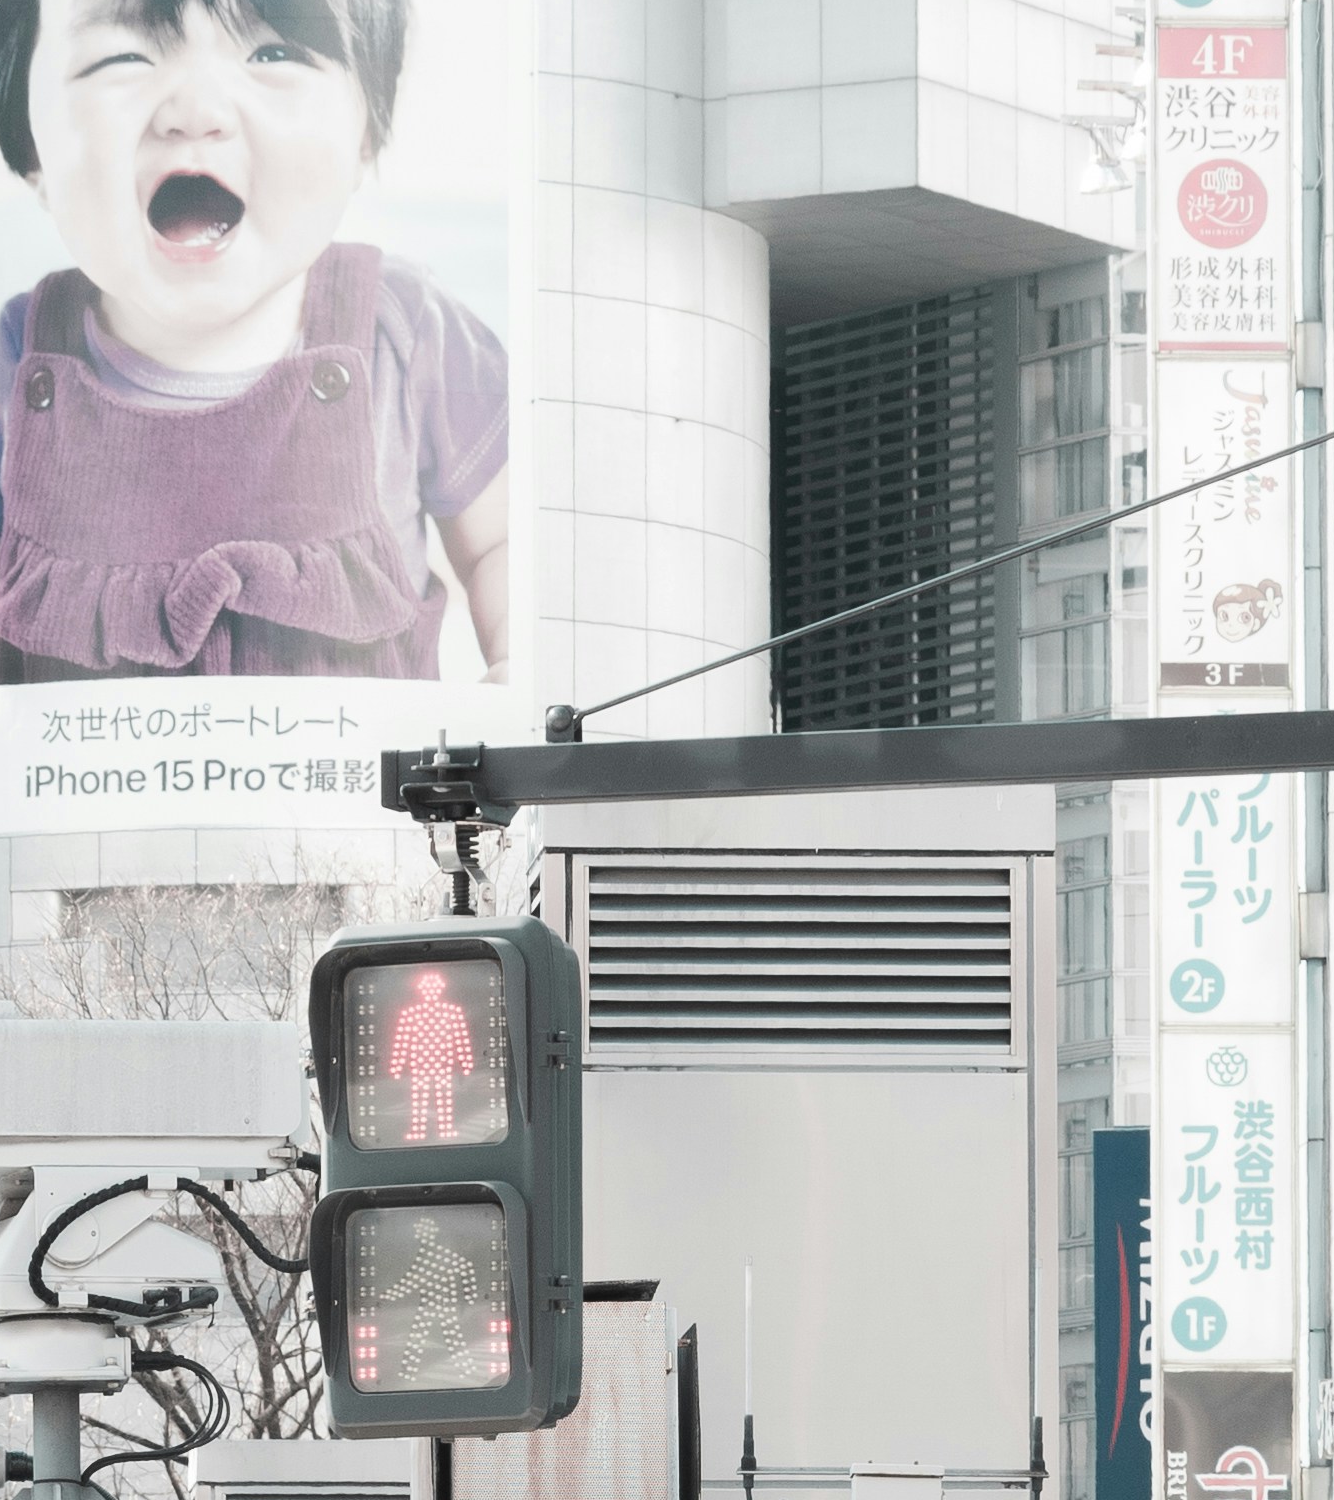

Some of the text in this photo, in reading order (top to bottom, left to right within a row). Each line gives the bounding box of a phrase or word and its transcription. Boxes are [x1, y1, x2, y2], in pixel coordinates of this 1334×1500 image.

[1192, 34, 1253, 75] 4F
[1165, 84, 1237, 119] 渋谷
[1165, 125, 1280, 152] クリニック
[1171, 256, 1278, 281] 形成外科
[1171, 283, 1278, 310] 美容外科
[1171, 313, 1278, 332] 美容皮膚科
[1182, 446, 1205, 655] レディースクリニック
[1205, 663, 1244, 685] 3F
[42, 702, 359, 744] 次世代のポートレート
[25, 757, 375, 799] iPhone 15 Proで撮影
[1177, 788, 1219, 948] パーラー
[1180, 970, 1216, 1003] 2F
[1233, 1101, 1275, 1271] 渋谷西村
[1178, 1125, 1221, 1285] フルーツ
[1185, 1308, 1217, 1341] 1F
